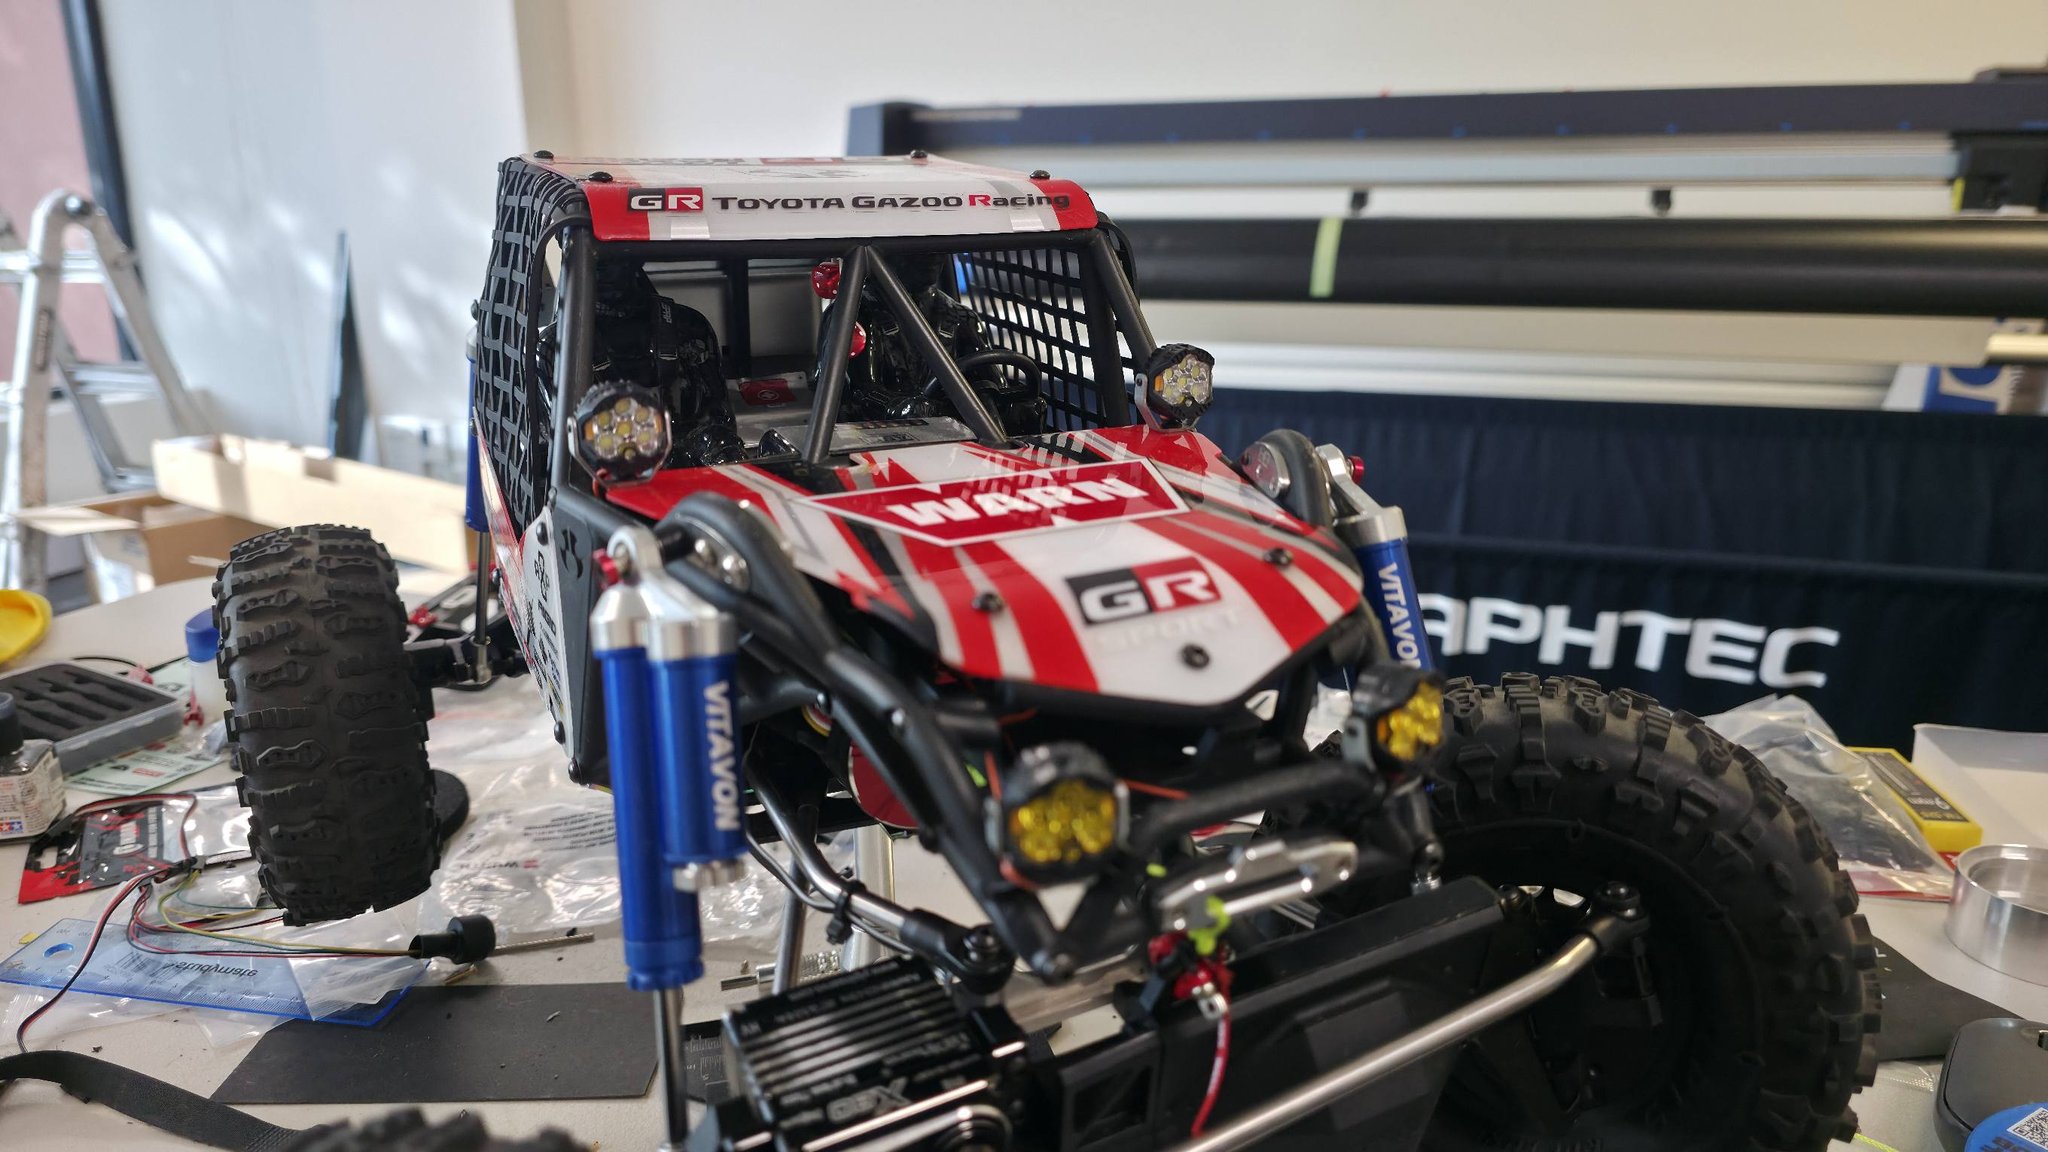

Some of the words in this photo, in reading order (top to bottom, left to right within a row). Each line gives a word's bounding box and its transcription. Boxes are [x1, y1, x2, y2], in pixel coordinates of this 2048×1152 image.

[630, 193, 702, 211] GR
[712, 197, 845, 210] TOYOTA
[851, 196, 963, 209] GAZOO
[968, 193, 1070, 210] Racing
[885, 477, 1150, 527] WARN
[1079, 568, 1218, 624] GR
[1416, 592, 1841, 689] APHTEC
[702, 679, 742, 832] VITAVON
